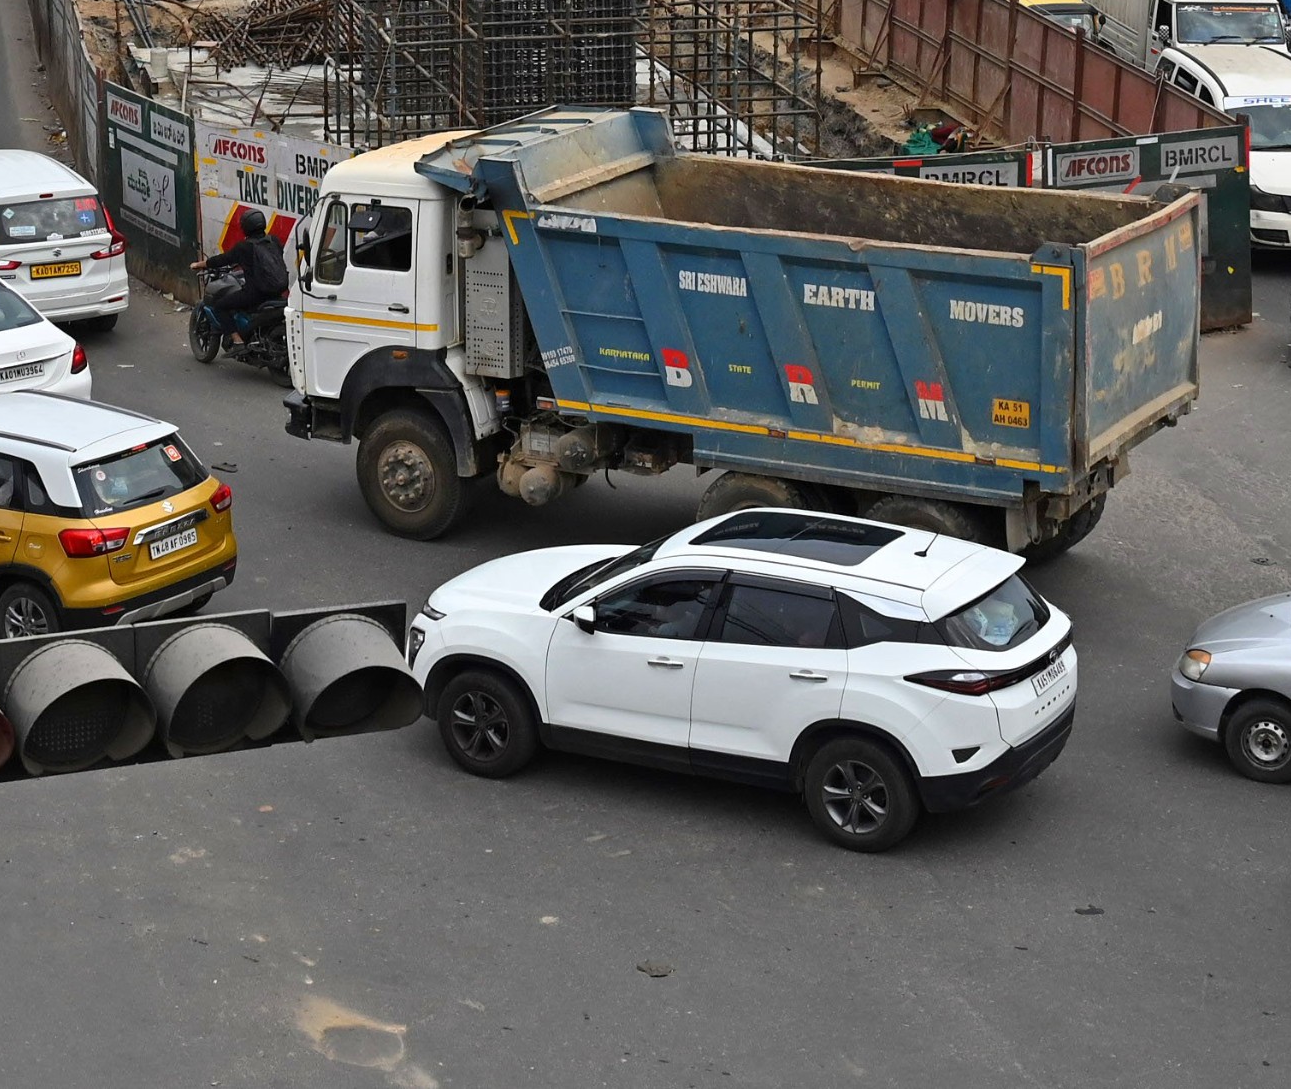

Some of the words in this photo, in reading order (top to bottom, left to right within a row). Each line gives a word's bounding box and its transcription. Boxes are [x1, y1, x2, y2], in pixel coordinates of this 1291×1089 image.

[1164, 146, 1233, 167] BMRCL
[236, 170, 268, 206] TAKE
[35, 262, 79, 276] KA01AM7255
[678, 270, 696, 290] SRI
[697, 272, 748, 297] ESHWARA
[804, 283, 875, 311] EARTH
[949, 299, 1025, 328] MOVERS
[599, 347, 650, 362] KARNATAKA
[0, 366, 43, 381] KA01MU3964
[728, 364, 752, 374] STATE
[661, 348, 693, 388] B
[784, 364, 819, 405] R
[914, 380, 949, 422] M
[851, 379, 881, 390] PERMIT
[998, 401, 1009, 412] KA
[1013, 402, 1023, 413] 51
[994, 413, 1006, 424] AH
[1008, 414, 1028, 427] 0463
[152, 545, 161, 556] TN
[170, 538, 179, 551] AF
